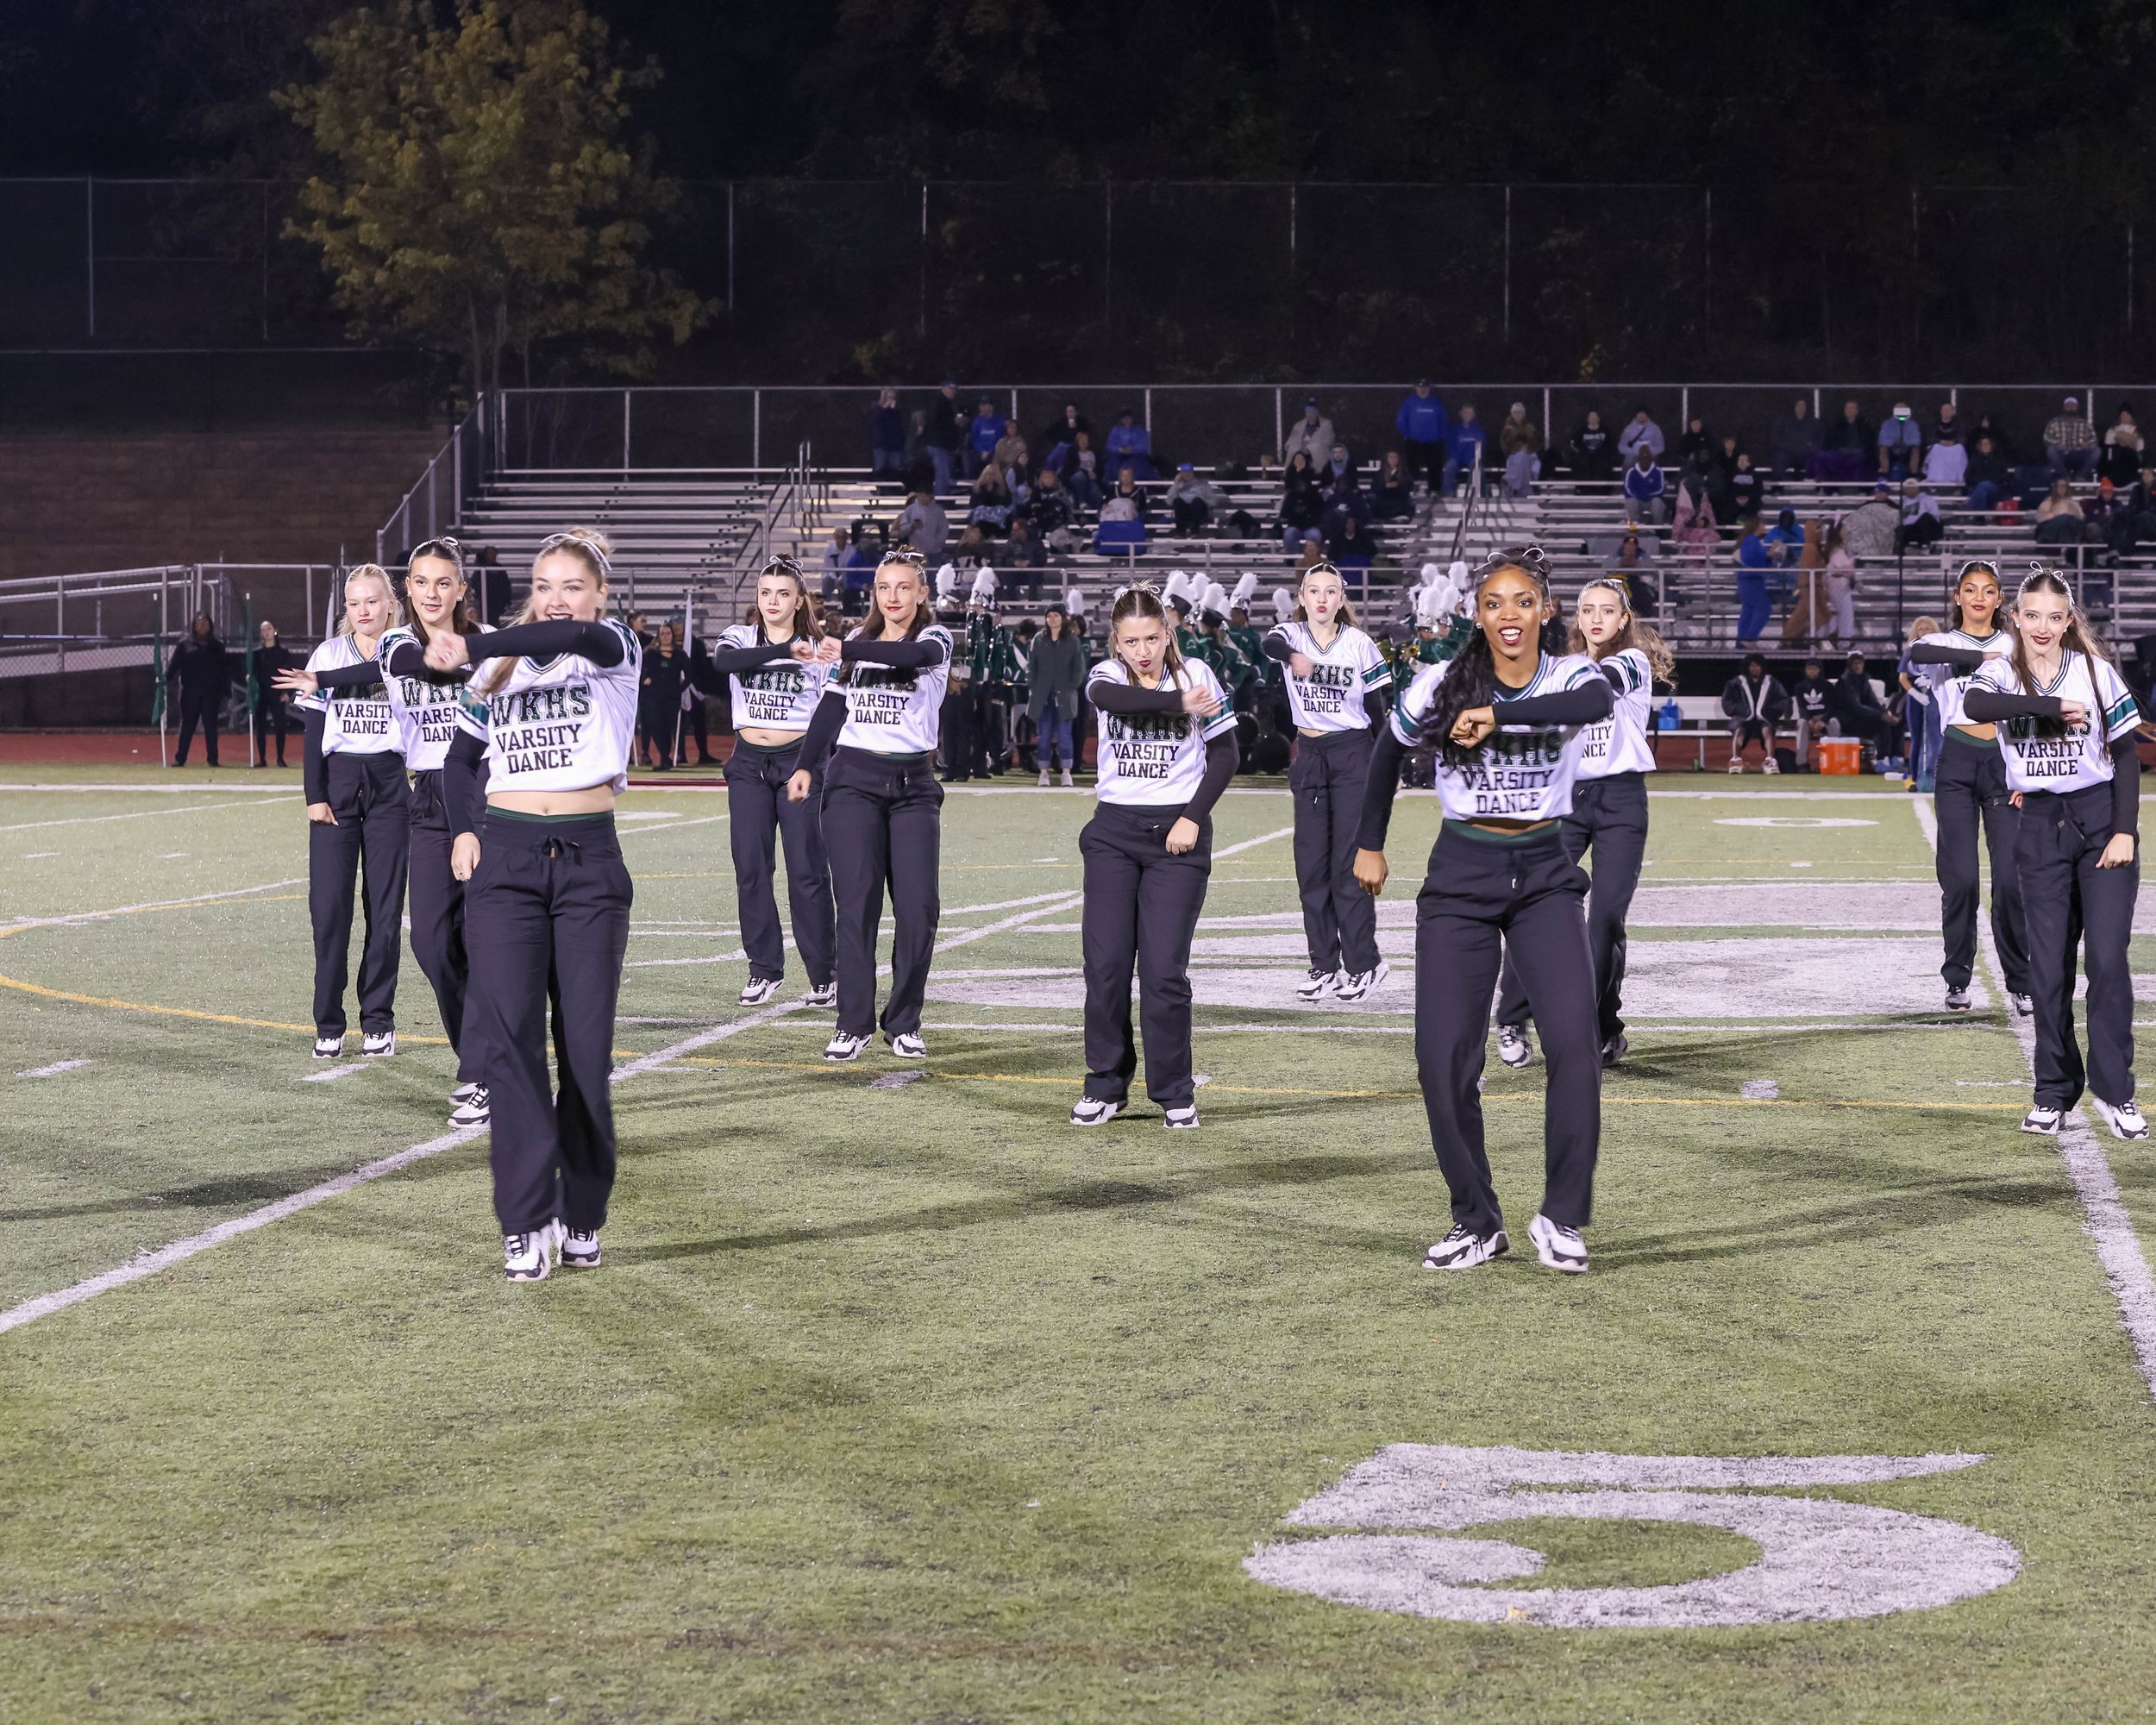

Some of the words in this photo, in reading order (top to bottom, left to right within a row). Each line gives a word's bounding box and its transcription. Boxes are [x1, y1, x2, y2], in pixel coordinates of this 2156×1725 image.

[1293, 662, 1356, 687] KHS
[743, 691, 796, 707] VARSITY
[851, 693, 910, 710] VARSITY
[1295, 685, 1347, 700] VARSITY
[492, 685, 592, 730] WKHS
[749, 706, 788, 720] DANCE
[1303, 699, 1341, 713] DANCE
[855, 709, 901, 724] DANCE
[342, 719, 388, 734] DANCE
[1107, 712, 1189, 742] WKHS
[496, 724, 582, 753] VARSITY
[1111, 743, 1180, 762] VARSITY
[1581, 743, 1606, 758] NCE
[2014, 740, 2084, 758] VARSITY
[507, 748, 573, 774] DANCE
[1118, 761, 1169, 779] DANCE
[2026, 759, 2078, 776] DANCE
[1462, 769, 1554, 790] VARSITY
[1476, 791, 1539, 813] DANCE
[1242, 1442, 2023, 1628] 5
